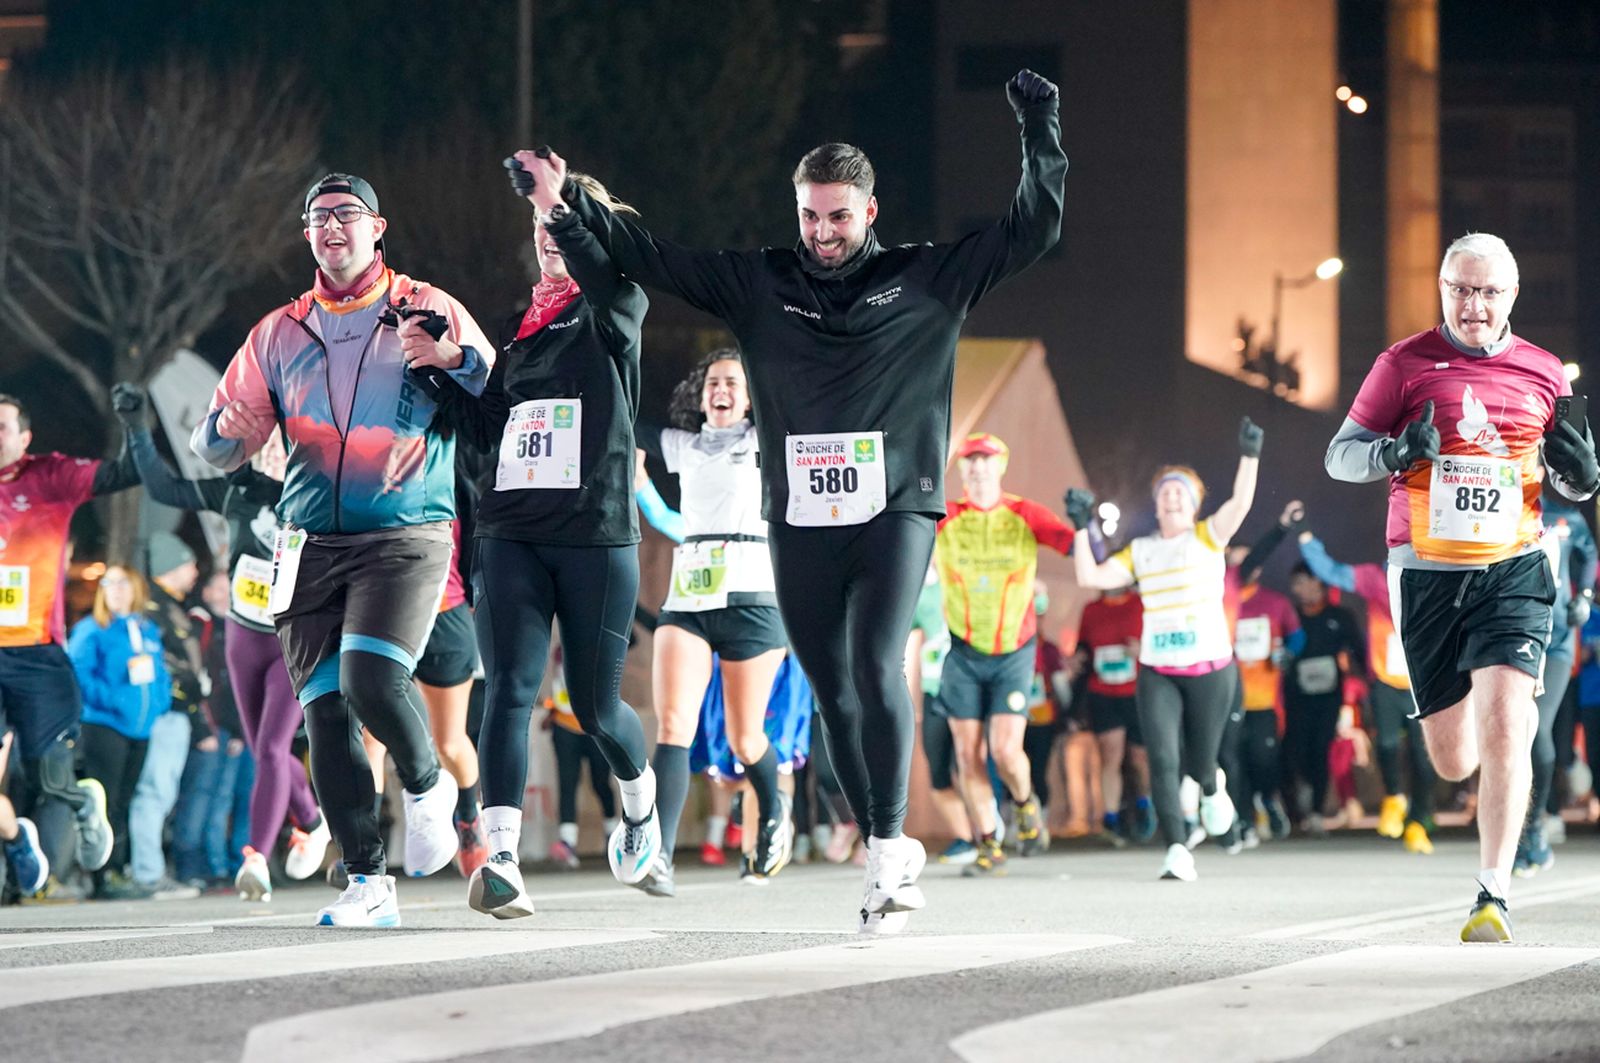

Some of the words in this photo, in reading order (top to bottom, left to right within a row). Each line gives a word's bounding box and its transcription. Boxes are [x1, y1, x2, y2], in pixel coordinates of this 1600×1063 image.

[783, 304, 822, 320] WILLIN
[548, 317, 579, 330] WILLIN
[516, 431, 553, 459] 581
[805, 445, 833, 454] NOCHE
[834, 444, 846, 453] DE
[796, 457, 812, 467] SAN
[1453, 465, 1481, 474] NOCHE
[1482, 467, 1492, 475] DE
[809, 467, 858, 494] 580
[1442, 474, 1460, 484] SAN
[1455, 486, 1501, 513] 852
[245, 580, 268, 601] 34
